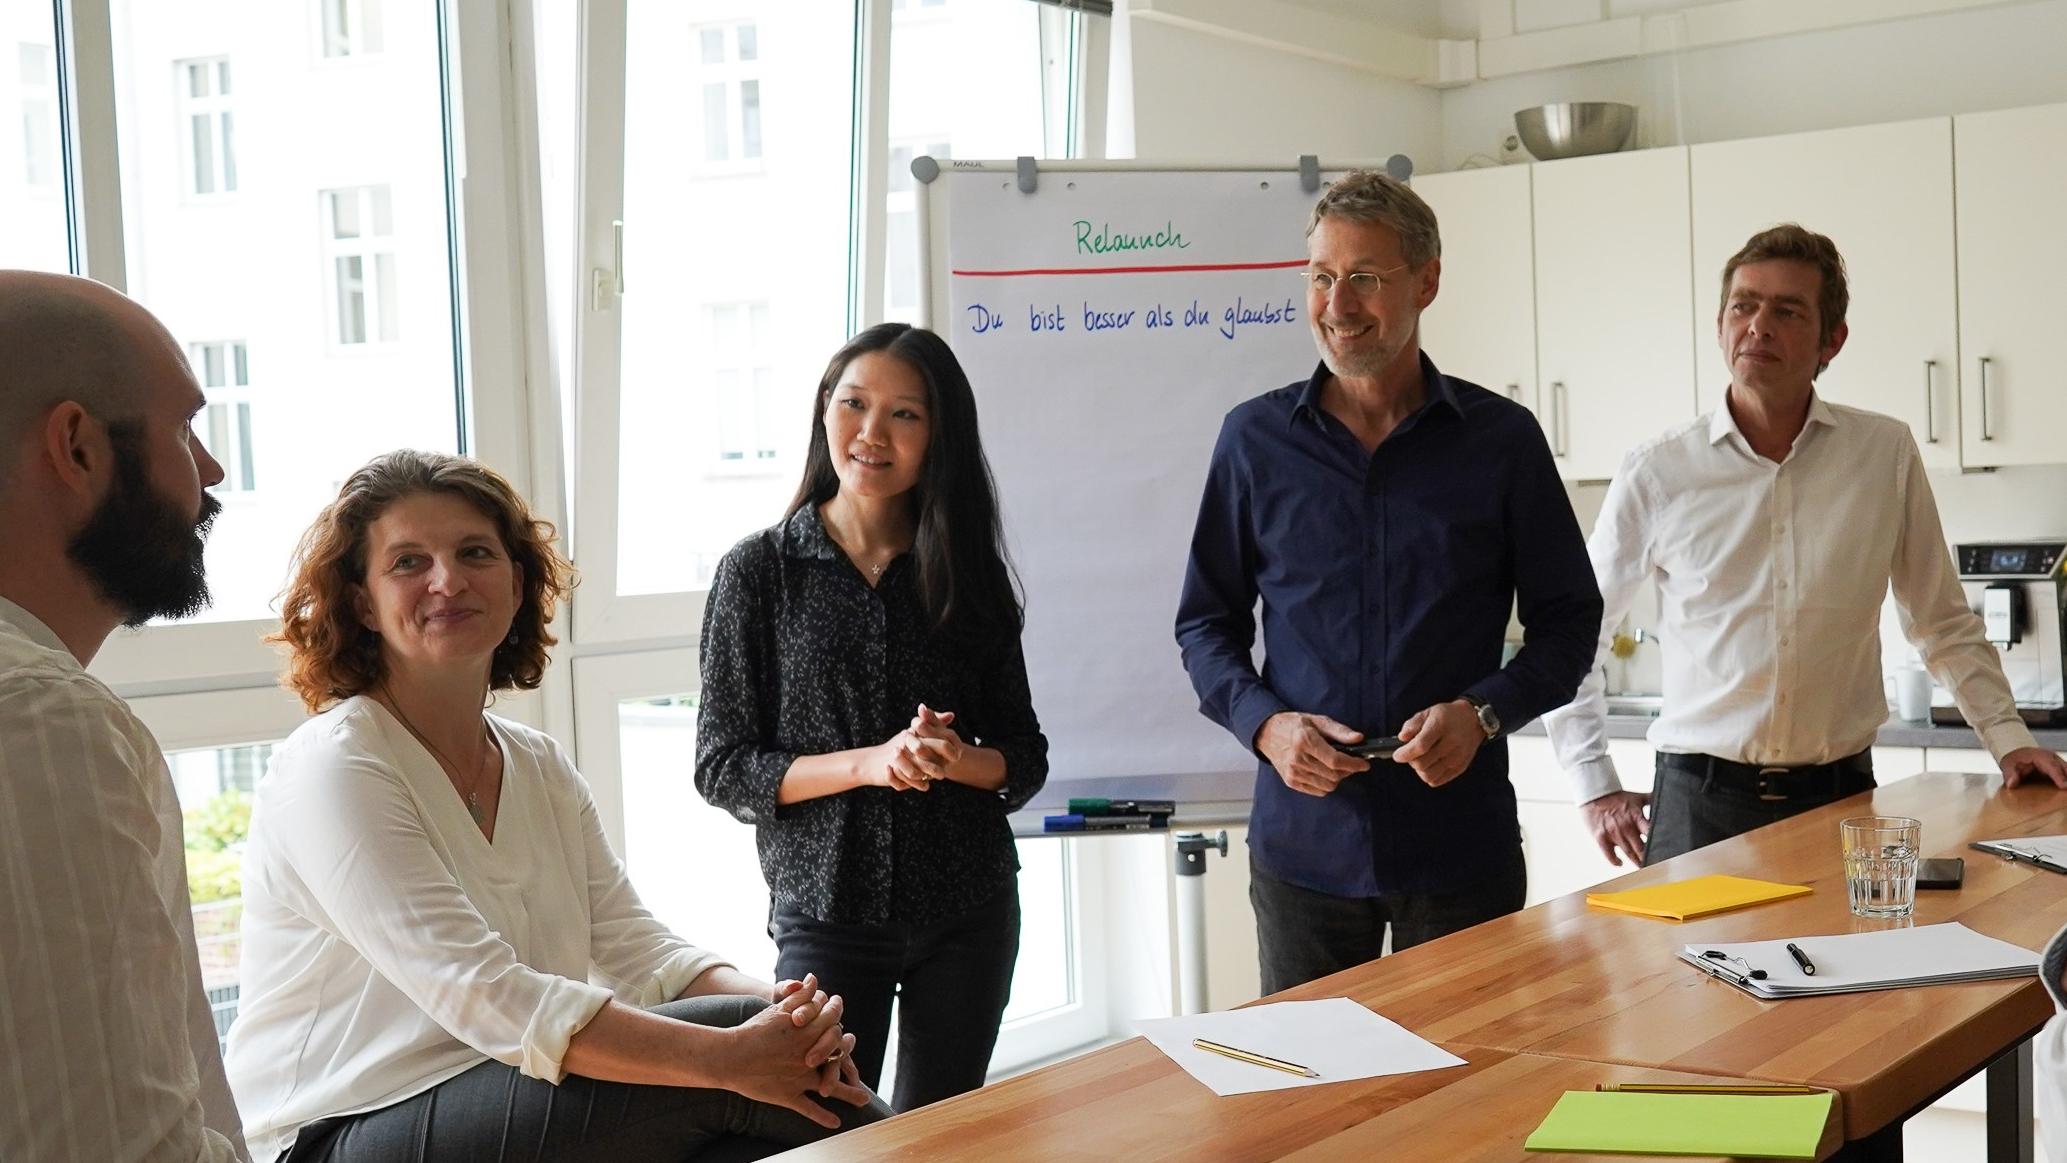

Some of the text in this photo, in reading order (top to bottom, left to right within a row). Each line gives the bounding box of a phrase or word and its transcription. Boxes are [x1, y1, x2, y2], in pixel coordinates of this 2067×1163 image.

[1073, 219, 1192, 255] Relaunch
[967, 297, 1297, 340] Du bist besser als du glaubst
